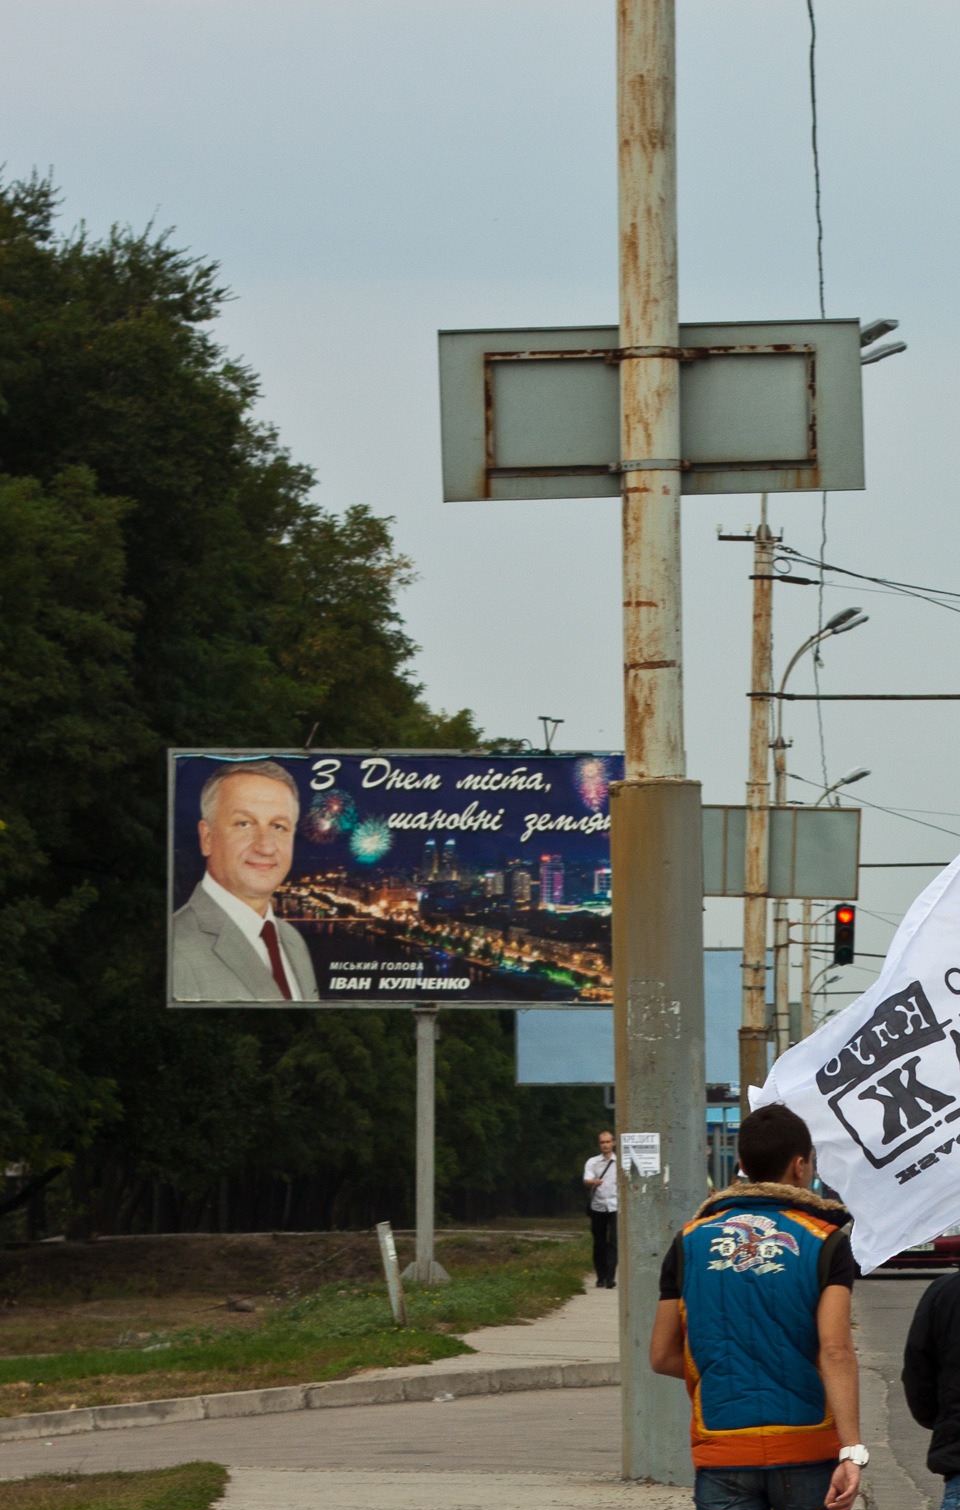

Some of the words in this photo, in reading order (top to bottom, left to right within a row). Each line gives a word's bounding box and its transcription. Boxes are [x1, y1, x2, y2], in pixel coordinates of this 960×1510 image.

[310, 758, 342, 790] З
[360, 757, 442, 790] Днем
[456, 766, 552, 793] міста,
[388, 800, 505, 831] шановні
[329, 960, 379, 971] МІСЬКИЙ
[380, 961, 424, 971] ГОЛОВА
[329, 977, 373, 990] ІВАН
[378, 977, 471, 990] КУЛІЧЕНКО
